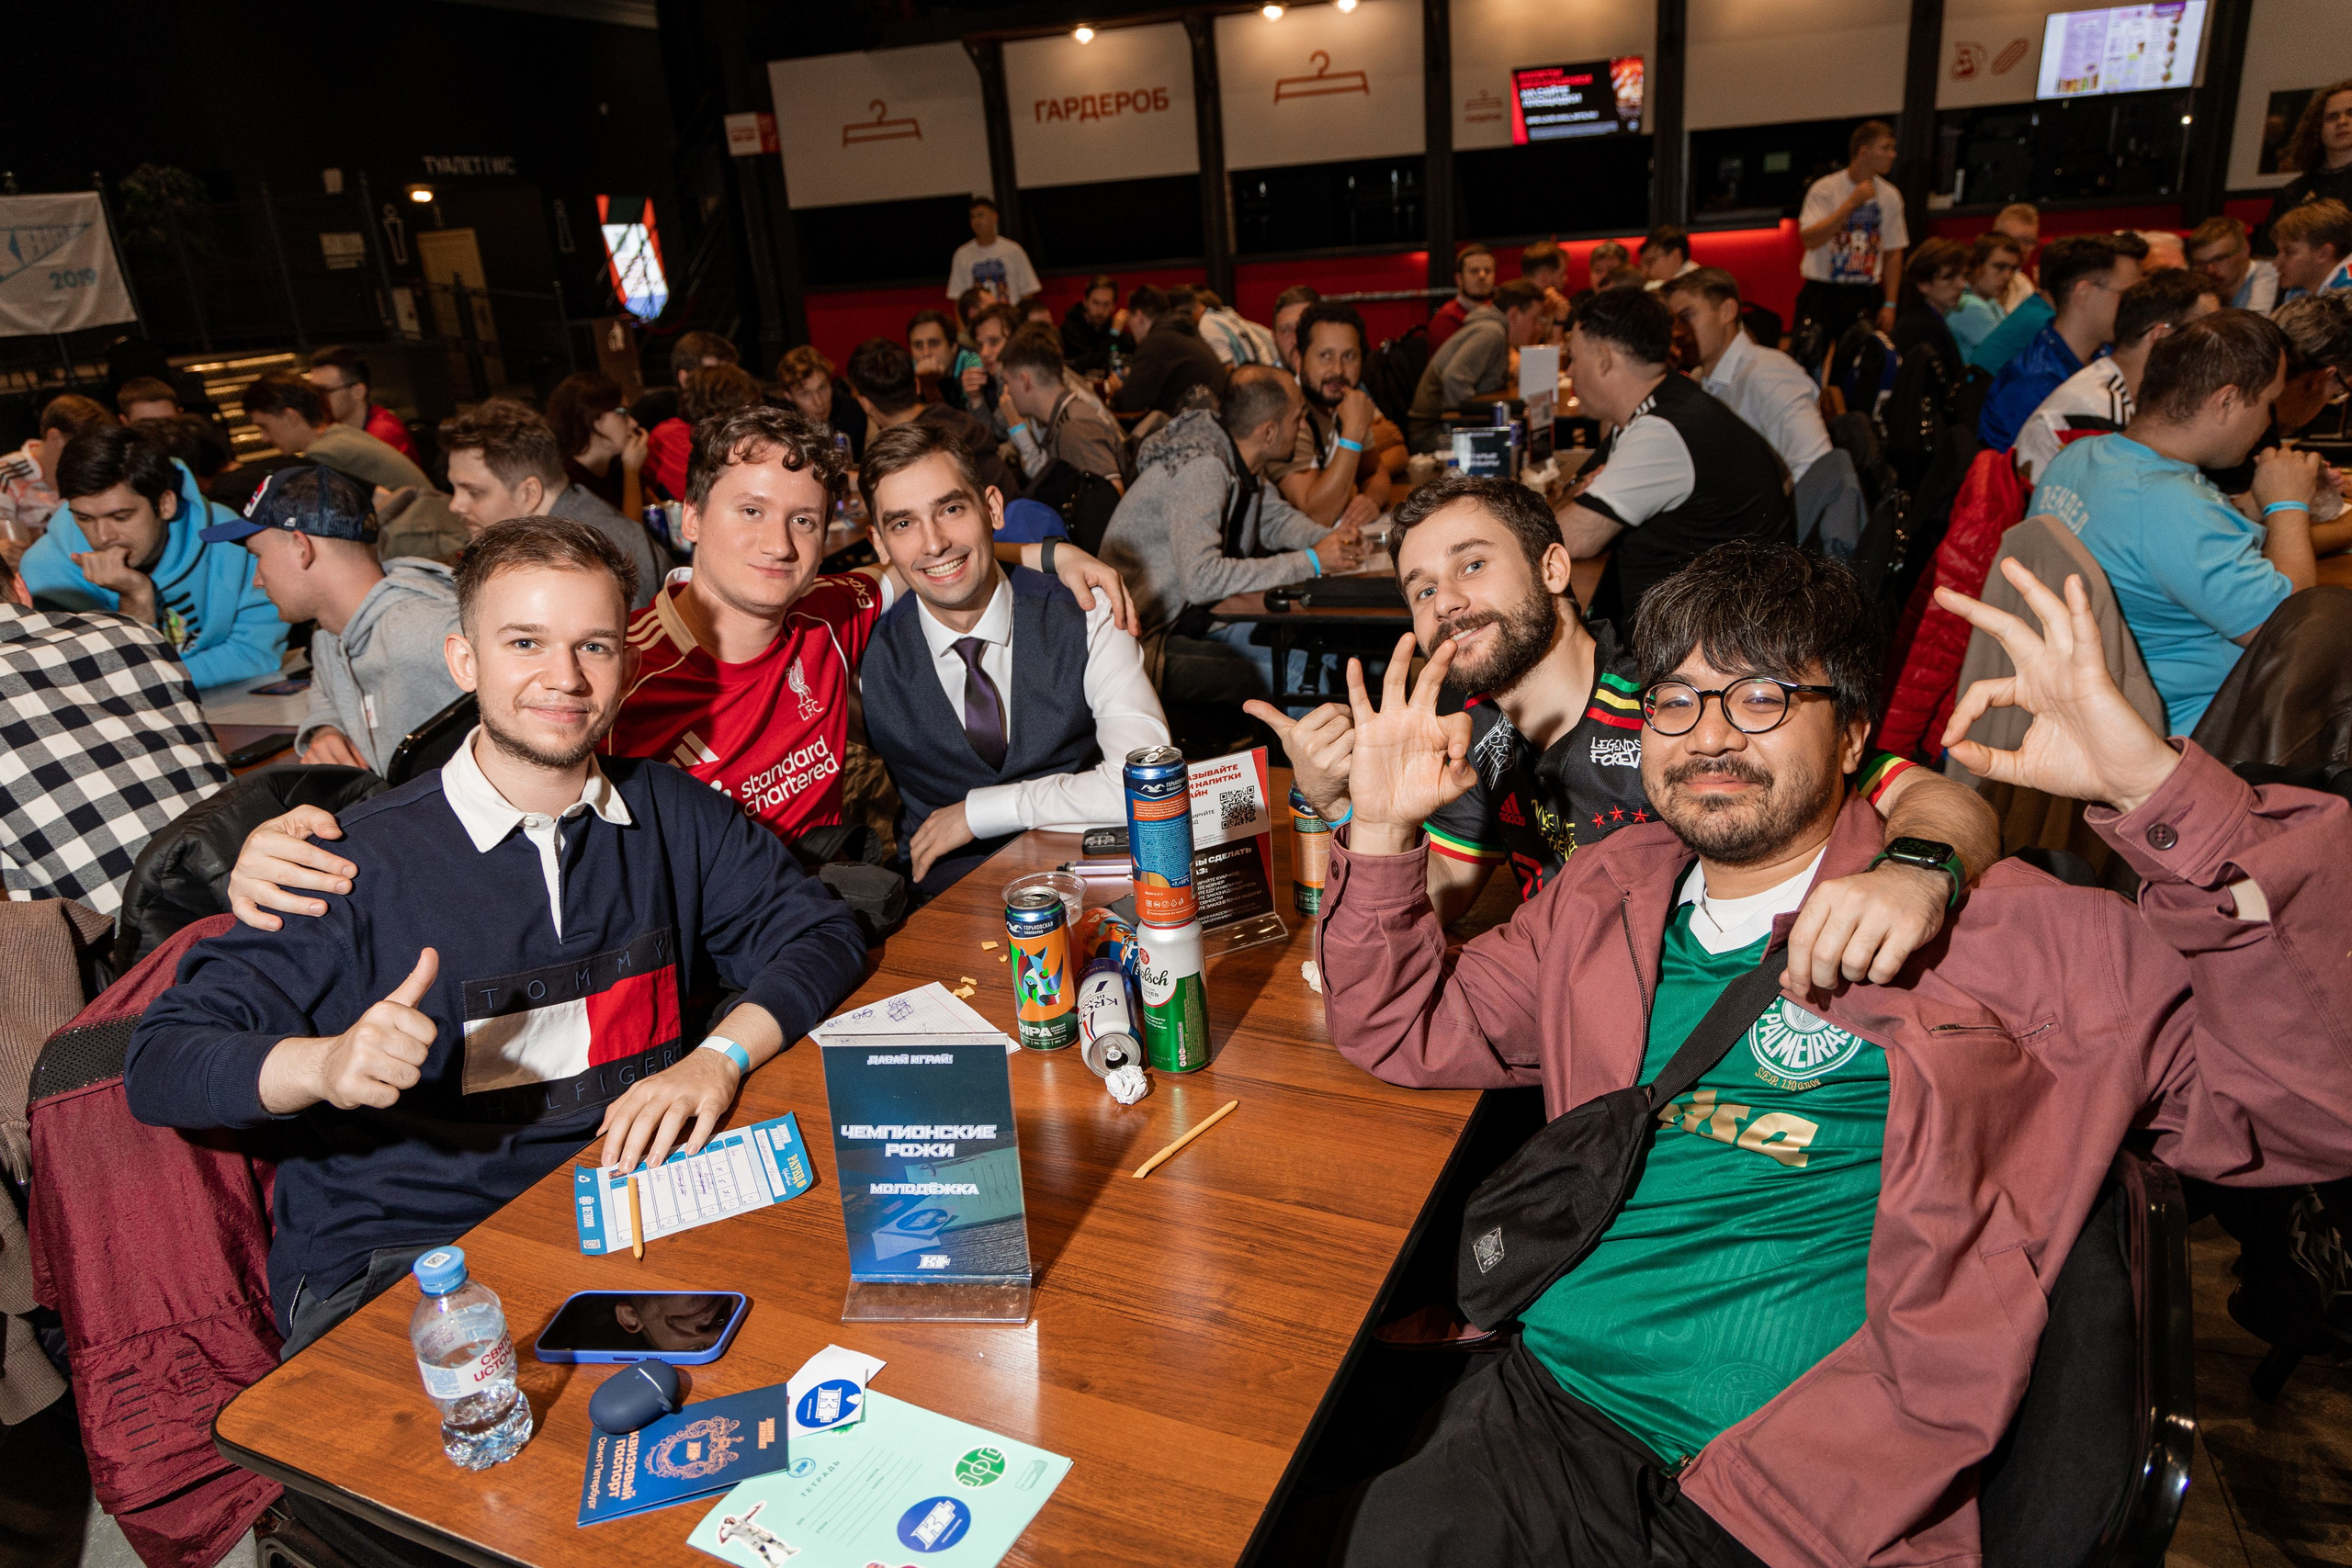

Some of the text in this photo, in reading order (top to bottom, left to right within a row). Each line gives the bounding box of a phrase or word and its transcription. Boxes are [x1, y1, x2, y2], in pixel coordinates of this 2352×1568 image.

[1035, 86, 1170, 123] ГАРДЕРОБ
[1590, 737, 1641, 753] LEGENDS
[741, 735, 829, 799] standard
[1590, 750, 1641, 769] FOREV
[1188, 764, 1238, 781] АЗЫВАЙТЕ
[1195, 773, 1241, 788] НАПИТКИ
[744, 752, 840, 817] chartered
[1190, 789, 1208, 799] АЙН
[1193, 809, 1216, 818] ИРУЙТЕ
[1499, 811, 1526, 827] adidas
[1208, 847, 1251, 863] СДЕЛАТЬ
[1199, 896, 1223, 905] ОВНОСТИ
[480, 939, 664, 1009] TOMMY
[1139, 967, 1169, 987] olsch
[1018, 1021, 1052, 1037] DIPA
[1758, 1013, 1852, 1069] PALMEIRAS
[866, 1054, 954, 1066] ДАВАЙ ИГРАЙ!
[840, 1124, 998, 1140] ЧЕМПИОНСКИЕ
[884, 1143, 956, 1157] РОЖИ
[787, 1153, 805, 1185] РАУНД
[869, 1181, 980, 1196] МОЛОДЁЖКА
[582, 1206, 595, 1228] BETBOOM
[481, 1330, 510, 1365] СВЯТО
[587, 1437, 607, 1509] Санкт-Петербург
[607, 1438, 627, 1497] паспорт
[800, 1461, 840, 1497] ТЕТРАДЬ
